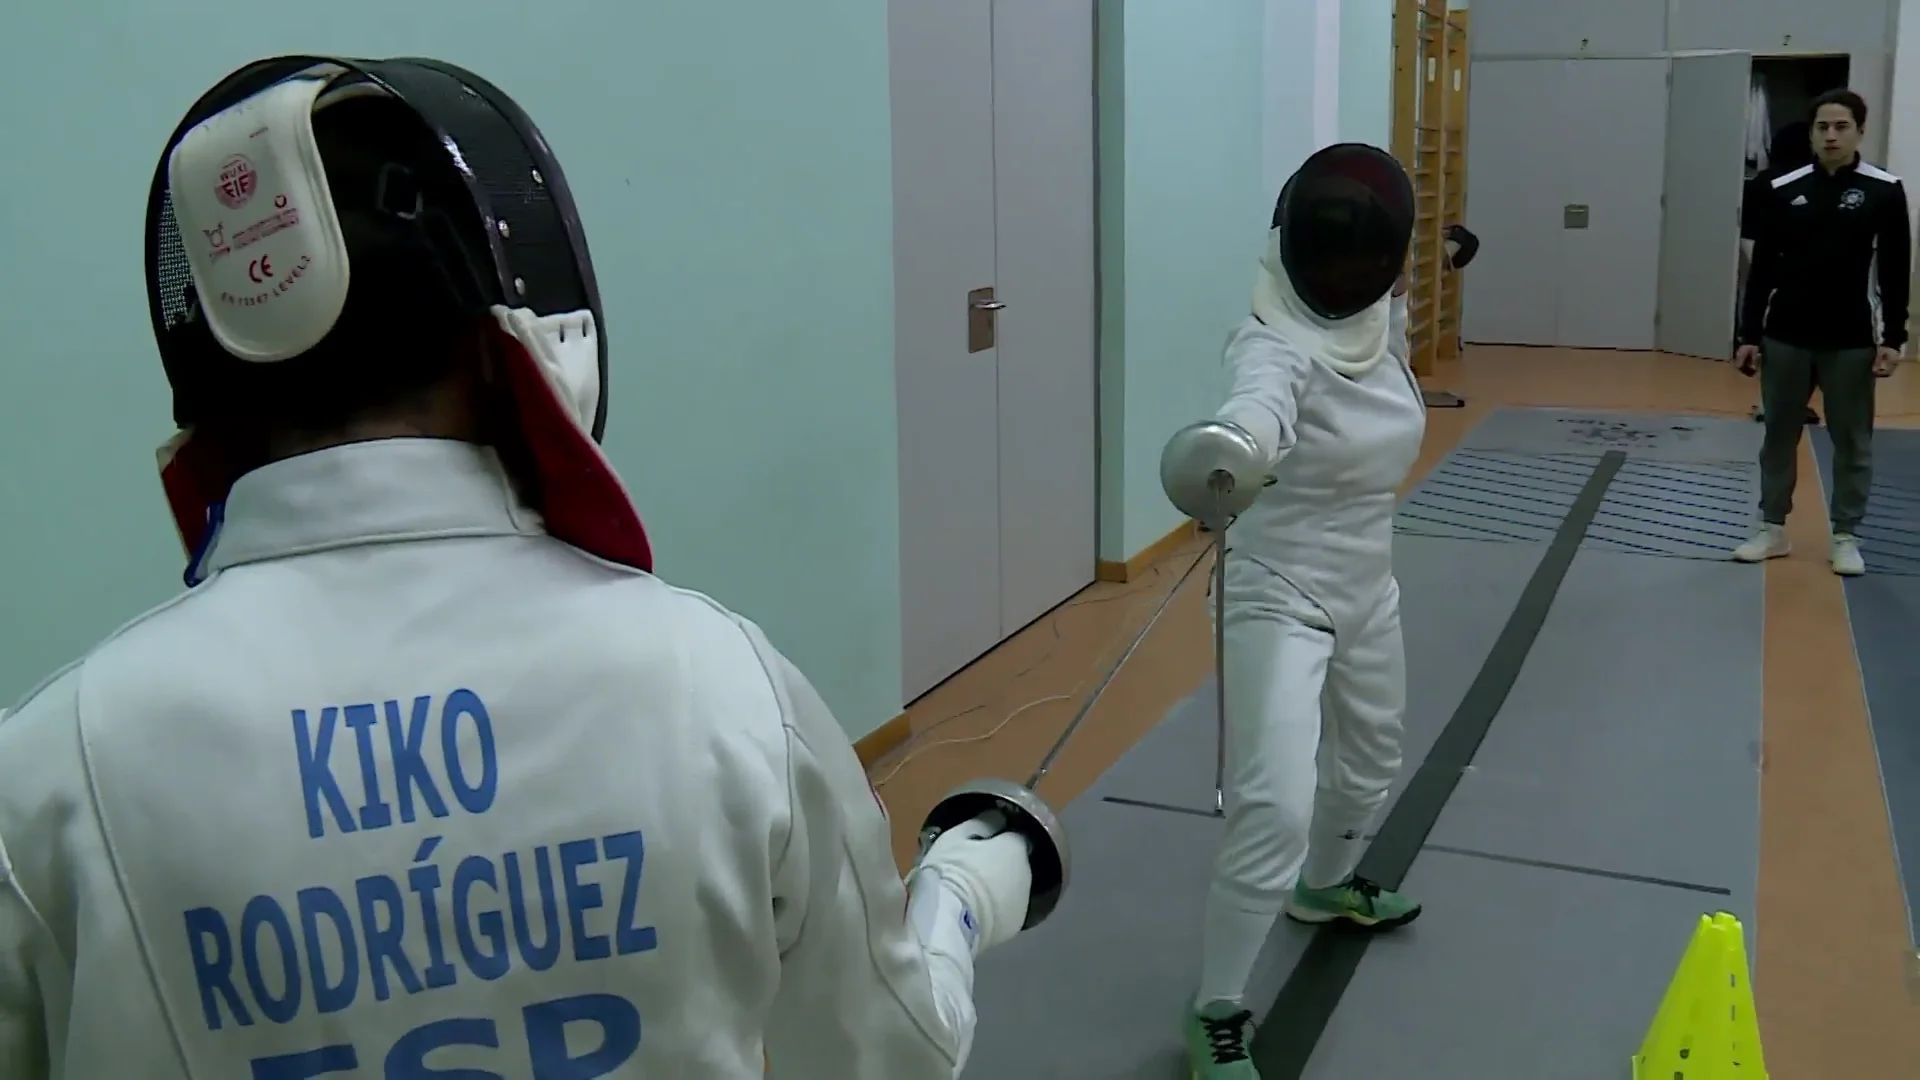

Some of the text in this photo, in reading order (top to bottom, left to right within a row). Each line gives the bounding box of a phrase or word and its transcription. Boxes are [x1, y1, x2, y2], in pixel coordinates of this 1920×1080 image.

[249, 254, 274, 283] CE
[291, 688, 498, 838] KIKO
[184, 830, 658, 1030] RODRÍGUEZ
[250, 992, 641, 1080] SP
